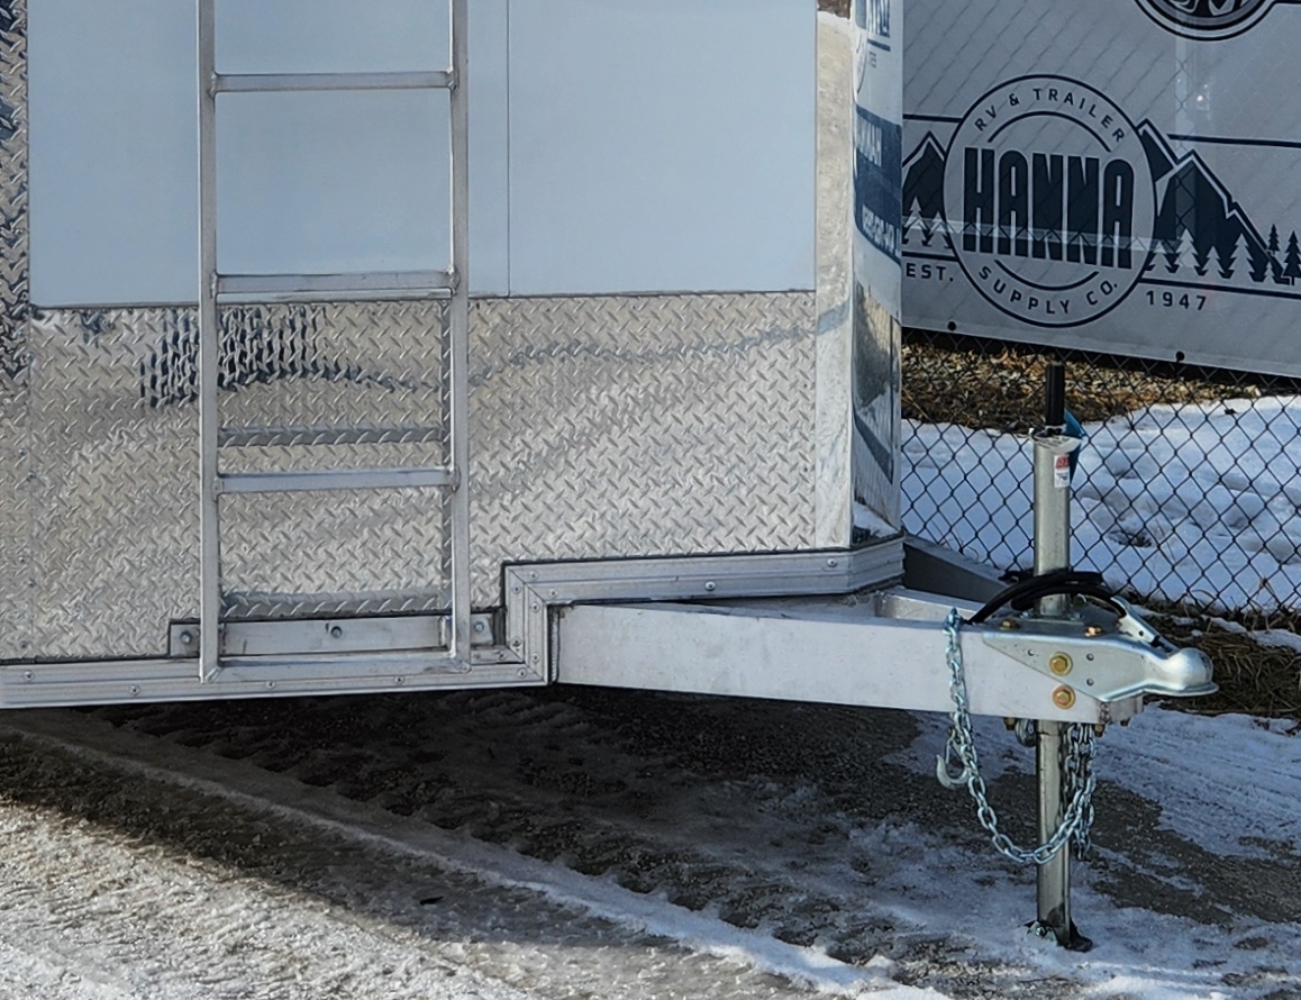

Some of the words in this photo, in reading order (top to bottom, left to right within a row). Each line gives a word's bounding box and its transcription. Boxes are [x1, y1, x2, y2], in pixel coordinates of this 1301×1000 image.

[974, 105, 999, 132] RV
[1009, 93, 1021, 107] &
[1032, 88, 1125, 142] TRAILER
[962, 147, 1135, 270] HANNA
[905, 262, 954, 282] EST.
[979, 266, 1070, 314] SUPPLY
[1086, 280, 1118, 306] CO.
[1146, 290, 1207, 311] 1947
